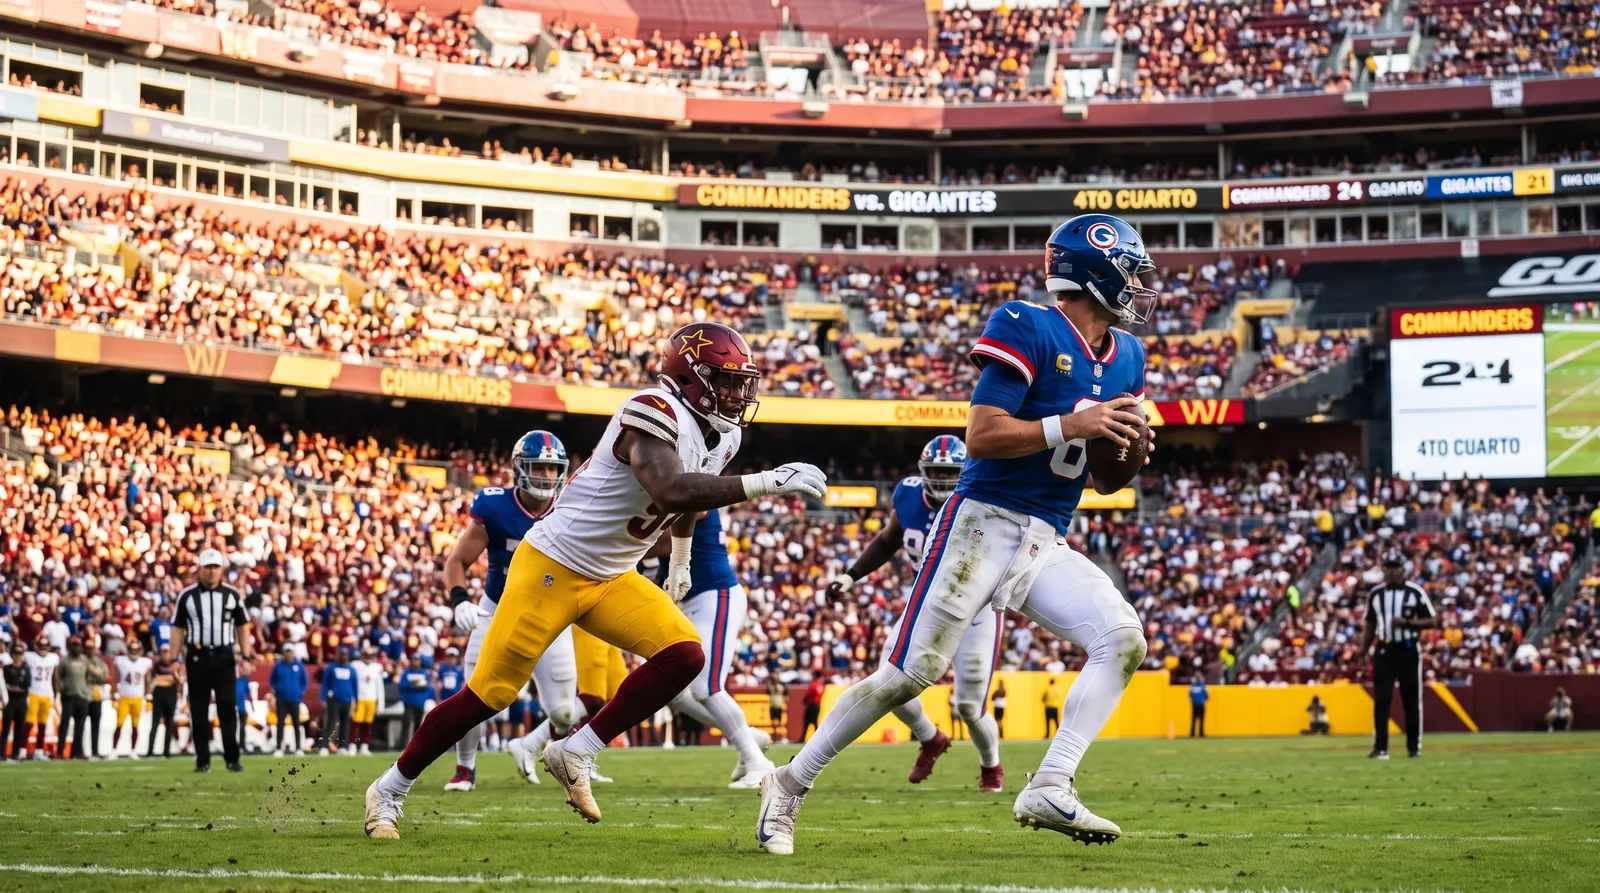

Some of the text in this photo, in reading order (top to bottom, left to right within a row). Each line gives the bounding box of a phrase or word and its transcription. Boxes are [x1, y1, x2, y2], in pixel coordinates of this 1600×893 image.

[1441, 175, 1513, 195] GIGANTES
[1527, 173, 1546, 189] 21
[696, 184, 850, 211] COMMANDERS
[888, 190, 997, 213] GIGANTES
[1073, 188, 1197, 210] 4TO CUARTO
[1230, 181, 1363, 205] COMMANDERS 24
[1400, 308, 1534, 335] COMMANDERS
[1055, 354, 1073, 372] C
[380, 368, 513, 406] COMMANDERS
[1418, 437, 1521, 457] 4TO CUARTO
